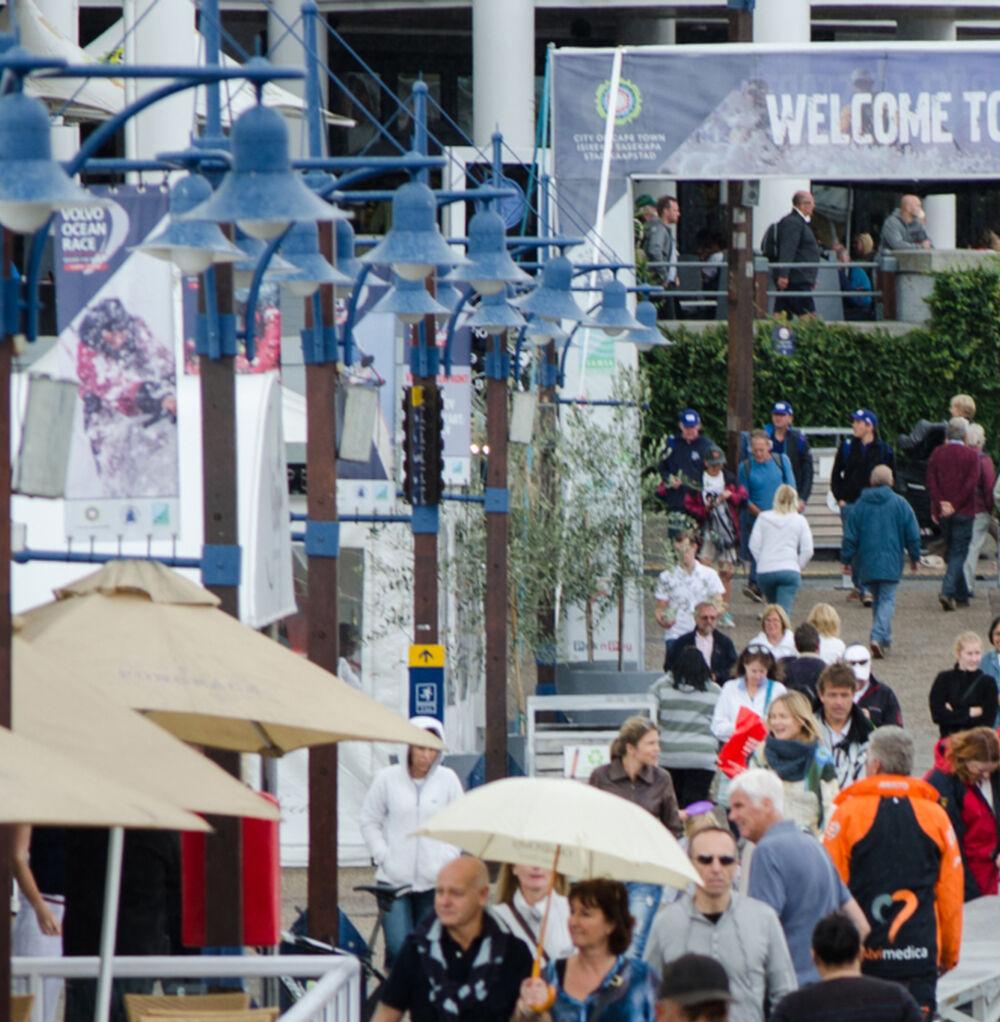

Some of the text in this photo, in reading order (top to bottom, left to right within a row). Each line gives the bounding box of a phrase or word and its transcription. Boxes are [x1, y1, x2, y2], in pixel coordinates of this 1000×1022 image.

[766, 91, 953, 147] WELCOME
[61, 207, 104, 220] VOLVO
[62, 222, 107, 236] OCEAN
[62, 237, 97, 251] RACE
